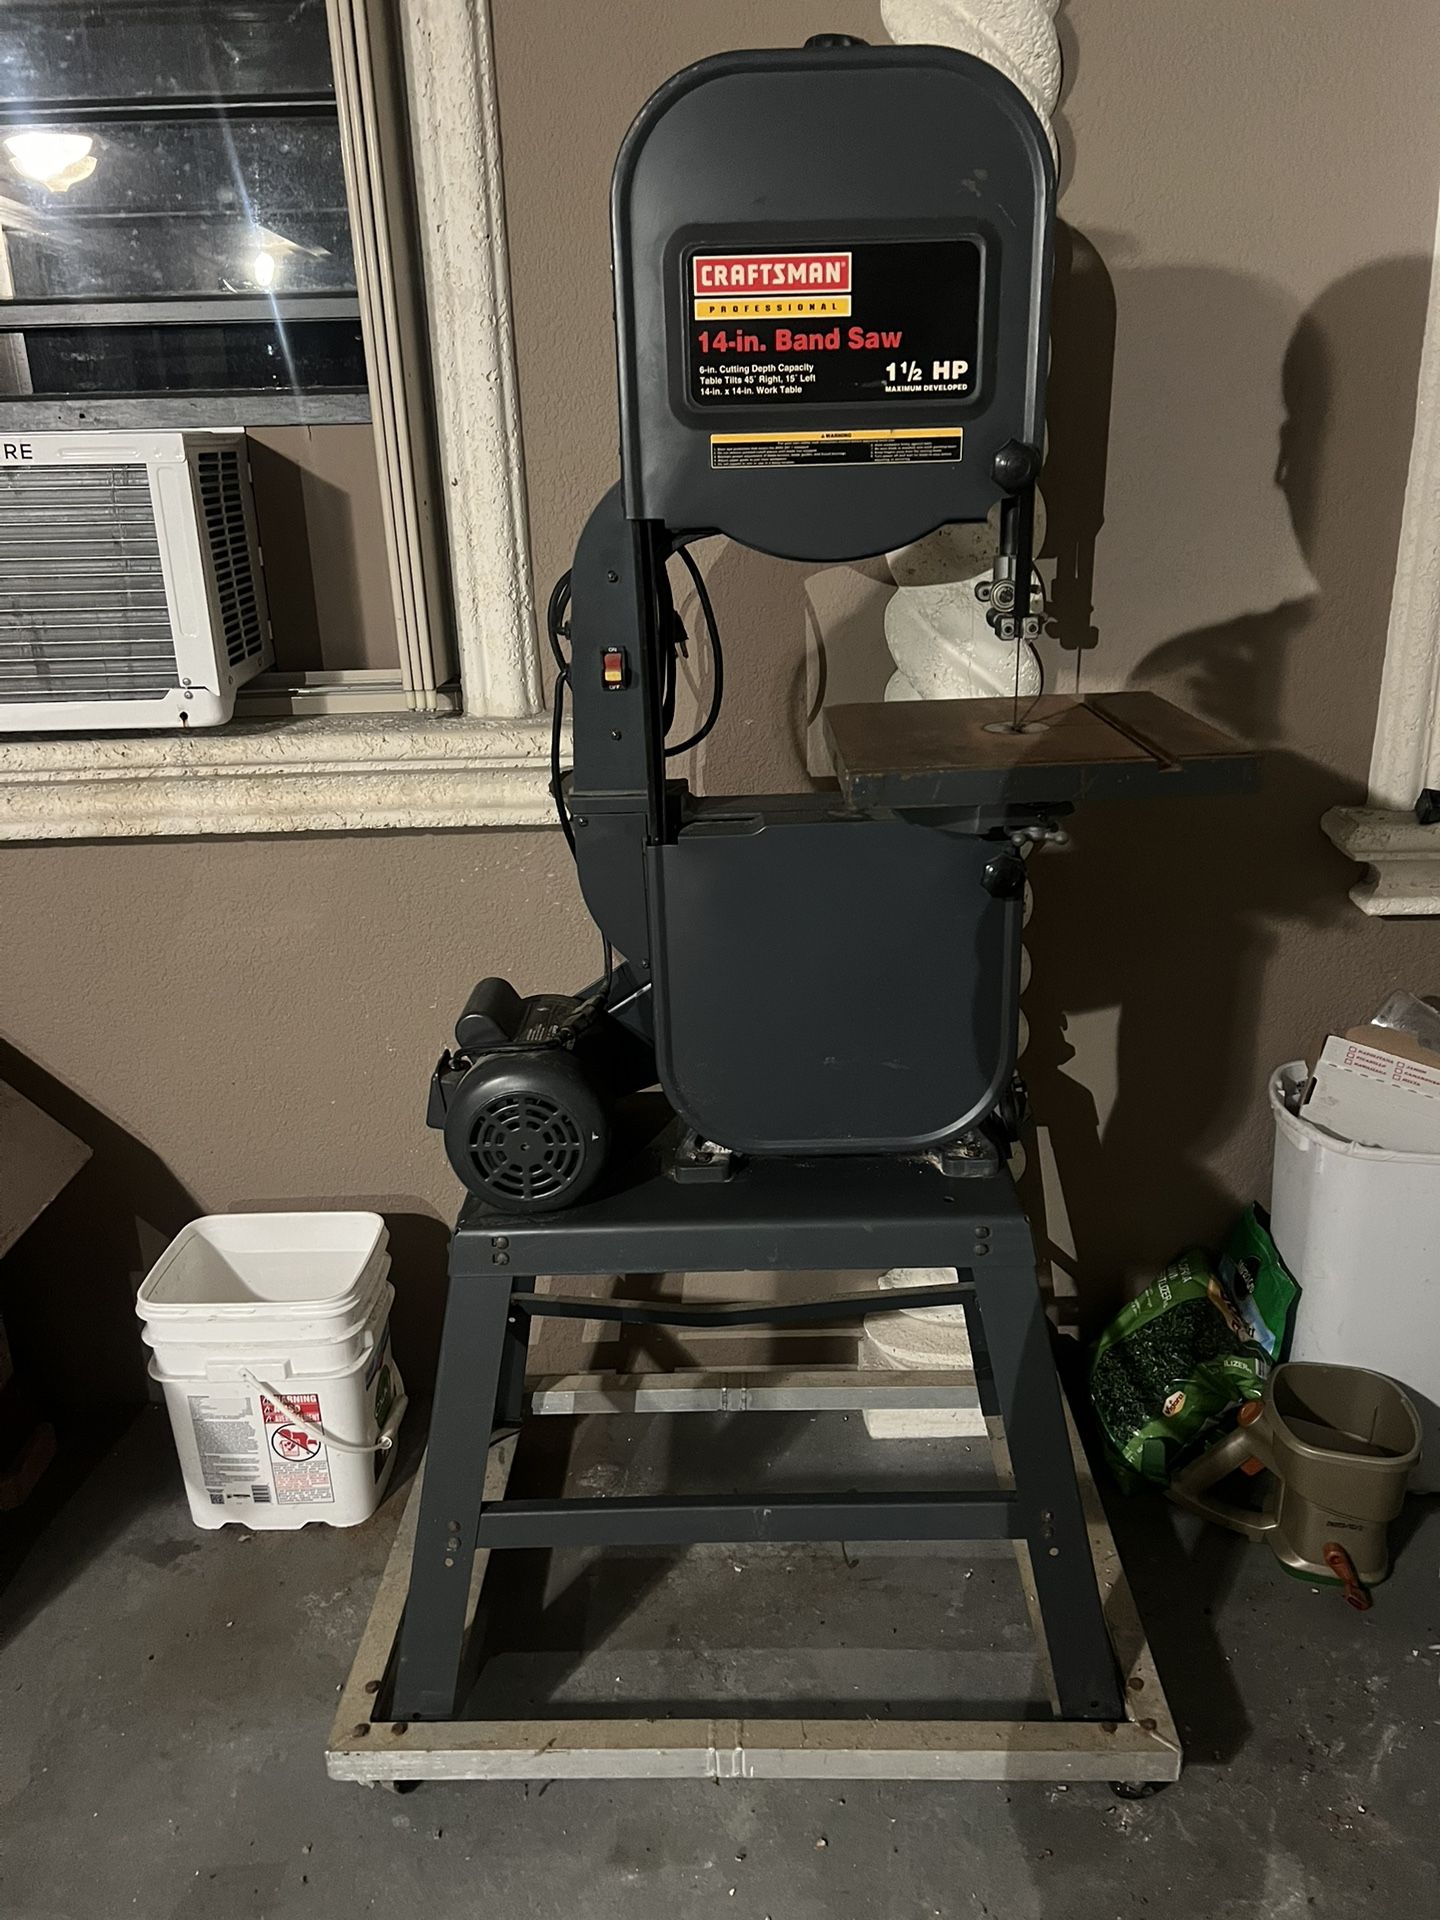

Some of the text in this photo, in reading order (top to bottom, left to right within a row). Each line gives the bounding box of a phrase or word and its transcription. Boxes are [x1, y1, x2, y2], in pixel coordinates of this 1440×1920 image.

[701, 262, 841, 286] CRAFTSMAN
[709, 302, 837, 314] PROFESSIONAL
[698, 326, 902, 353] 14-in. Band Saw
[699, 363, 814, 375] 6-in. Cutting Depth Capacity
[933, 360, 968, 380] HP
[700, 376, 723, 385] Table
[724, 375, 742, 384] Tilts
[800, 374, 816, 383] Left
[700, 387, 723, 396] 14-in.
[732, 386, 754, 395] 14-in.
[756, 386, 778, 394] Work
[780, 385, 802, 394] Table
[885, 385, 922, 393] MAXIMUM
[4, 443, 33, 460] RE
